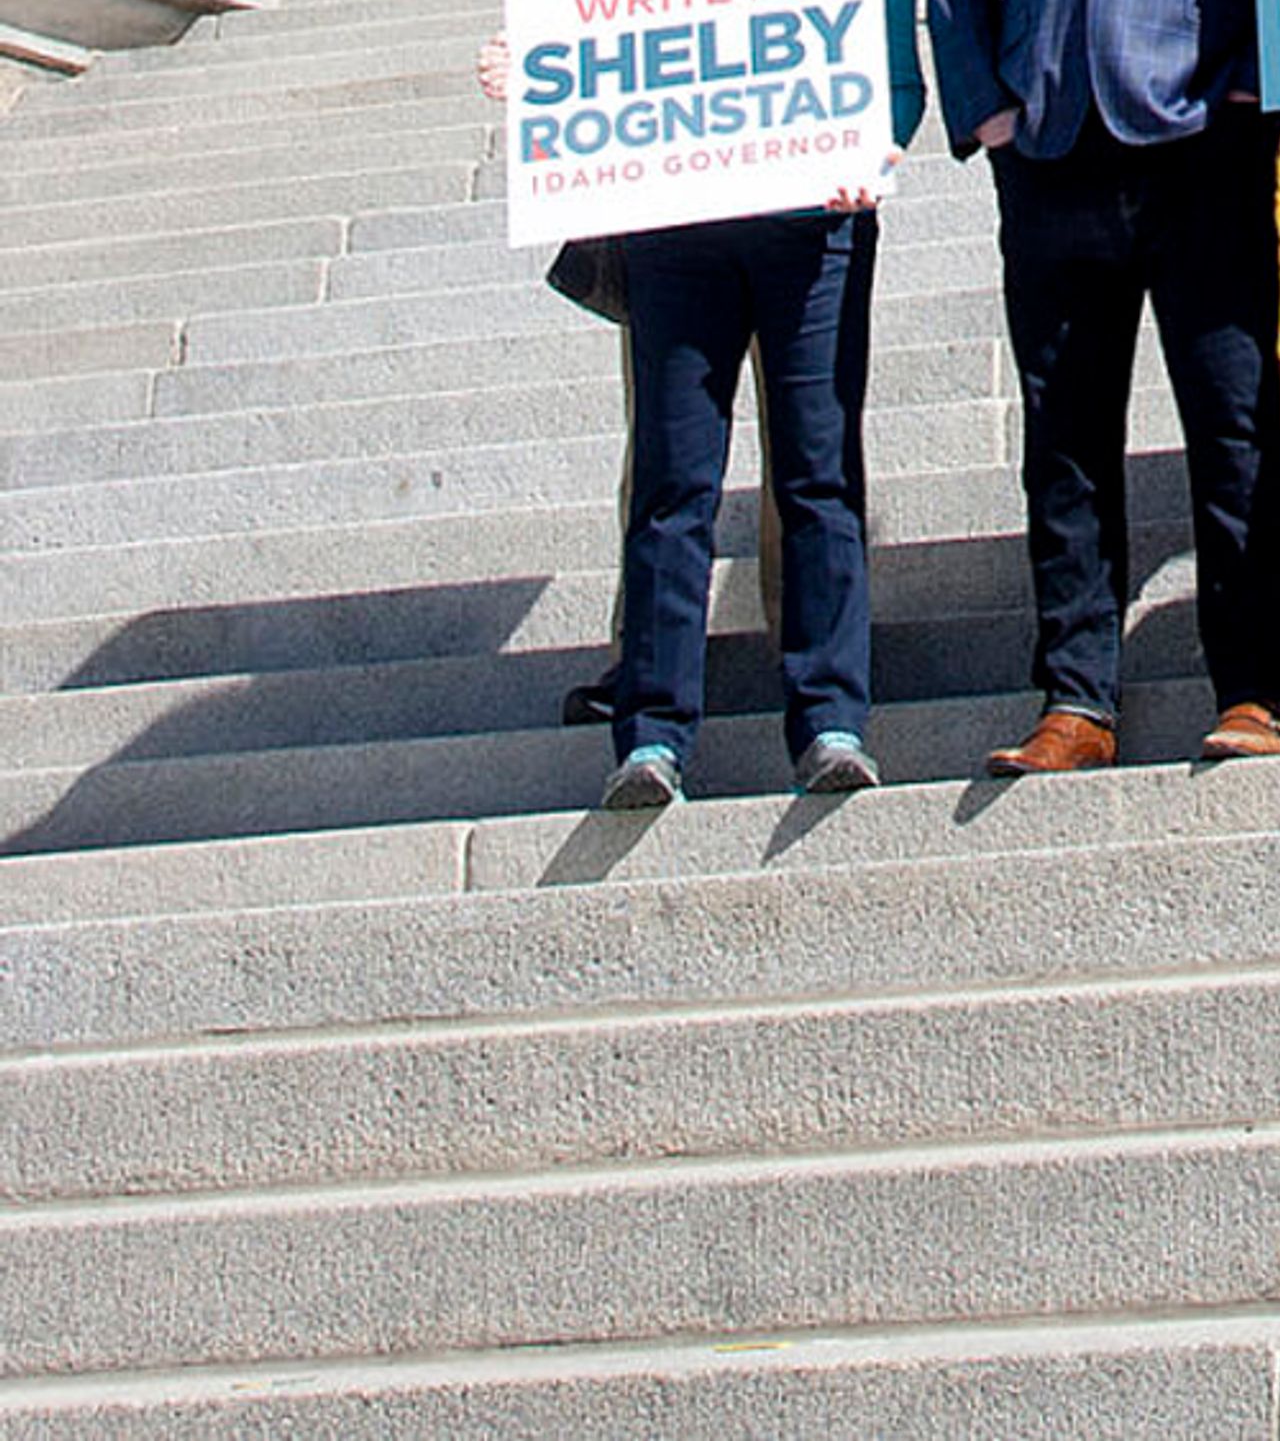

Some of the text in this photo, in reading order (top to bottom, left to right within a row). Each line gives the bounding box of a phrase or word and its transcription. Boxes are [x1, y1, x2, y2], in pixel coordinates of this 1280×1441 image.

[522, 0, 863, 105] SHELBY
[520, 72, 874, 163] ROGNSTAD
[532, 130, 861, 196] IDAHO GOVERNOR
